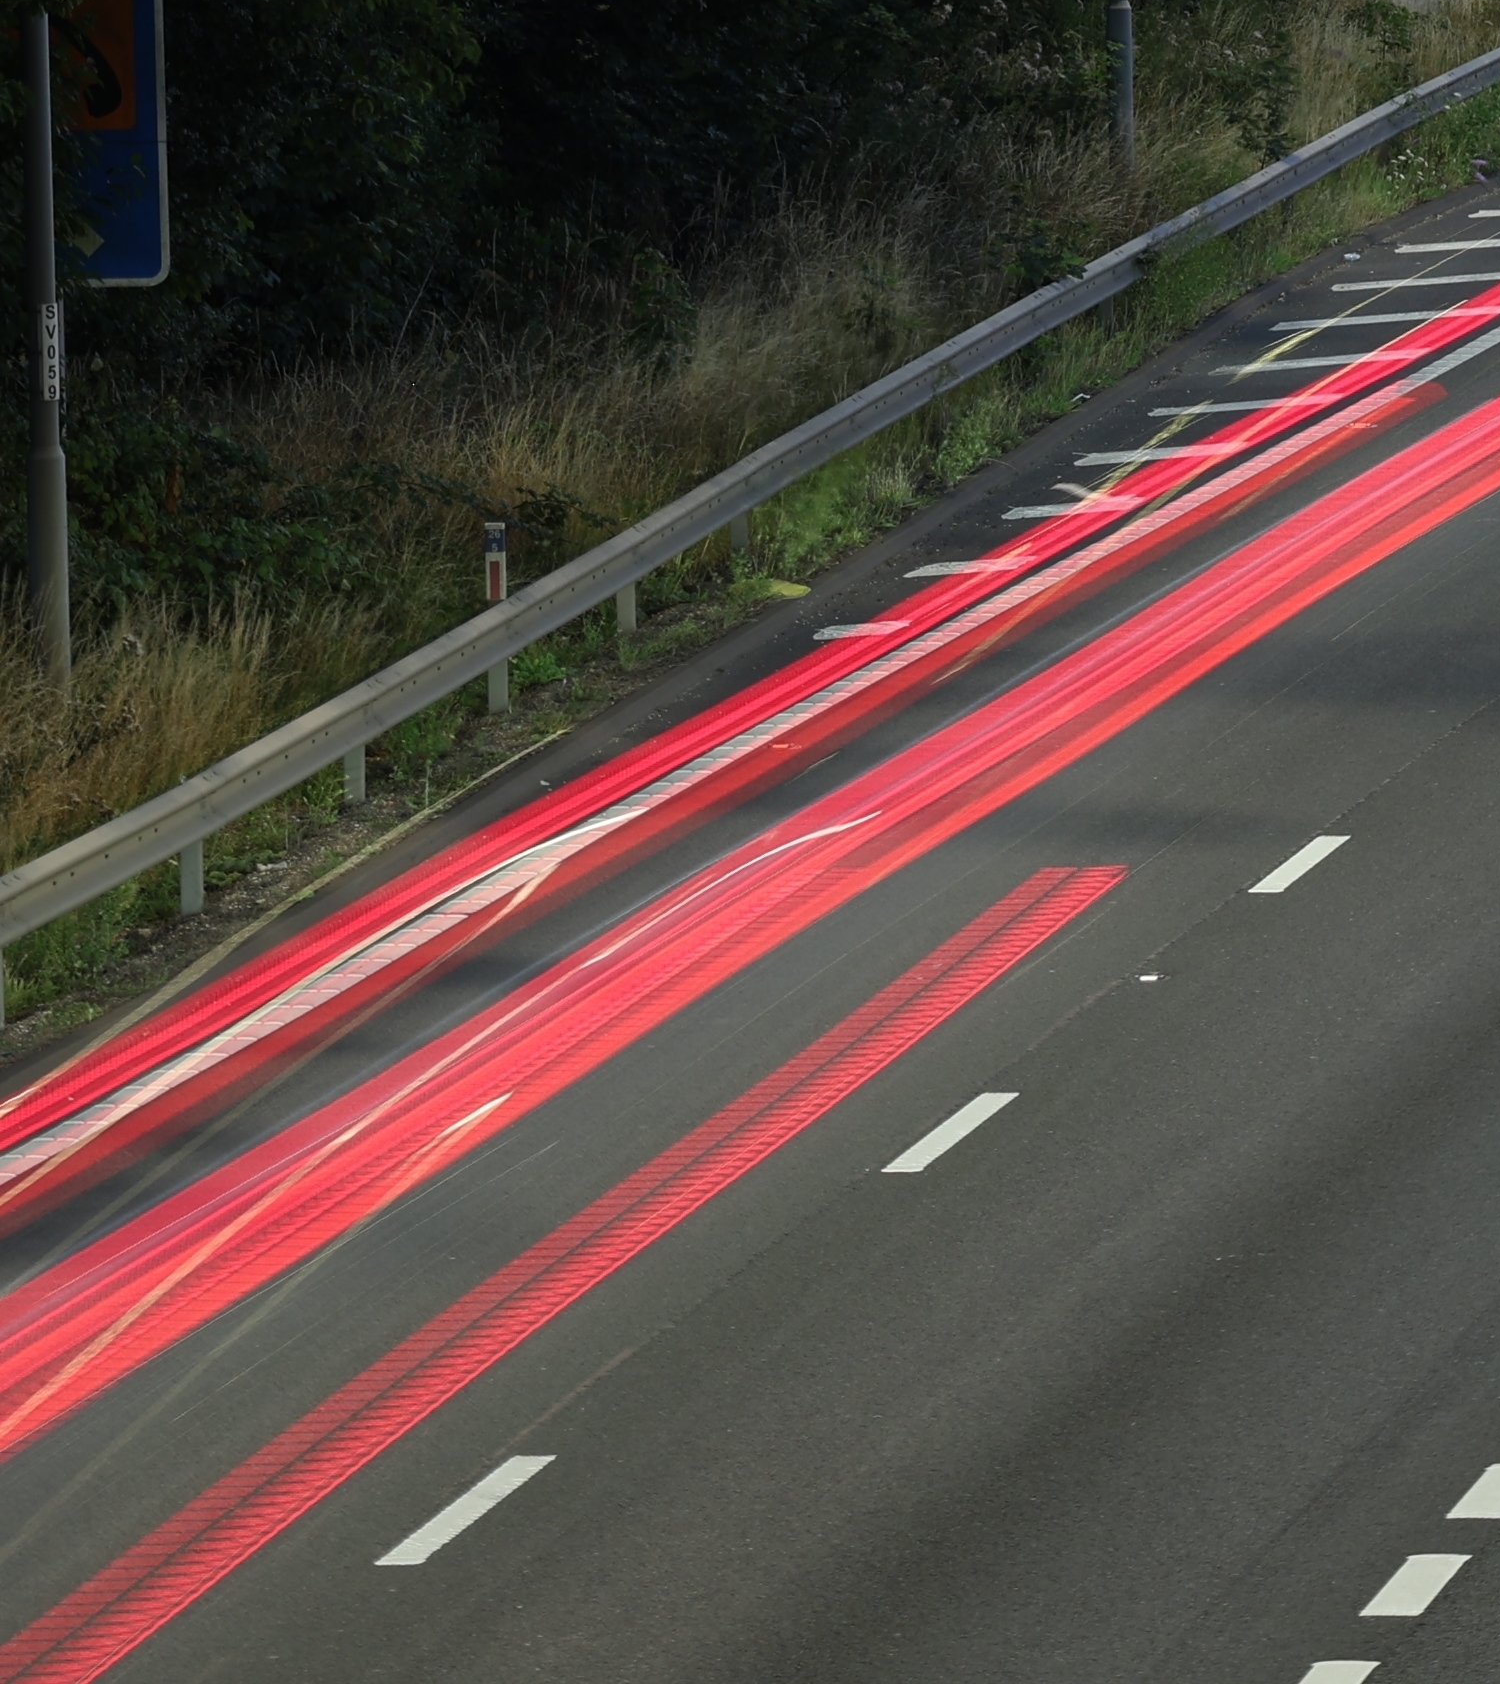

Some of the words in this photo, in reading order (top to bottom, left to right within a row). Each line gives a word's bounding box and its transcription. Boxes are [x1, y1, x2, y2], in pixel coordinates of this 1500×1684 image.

[45, 304, 57, 400] SV059
[488, 530, 501, 539] 26
[491, 543, 498, 552] 5
